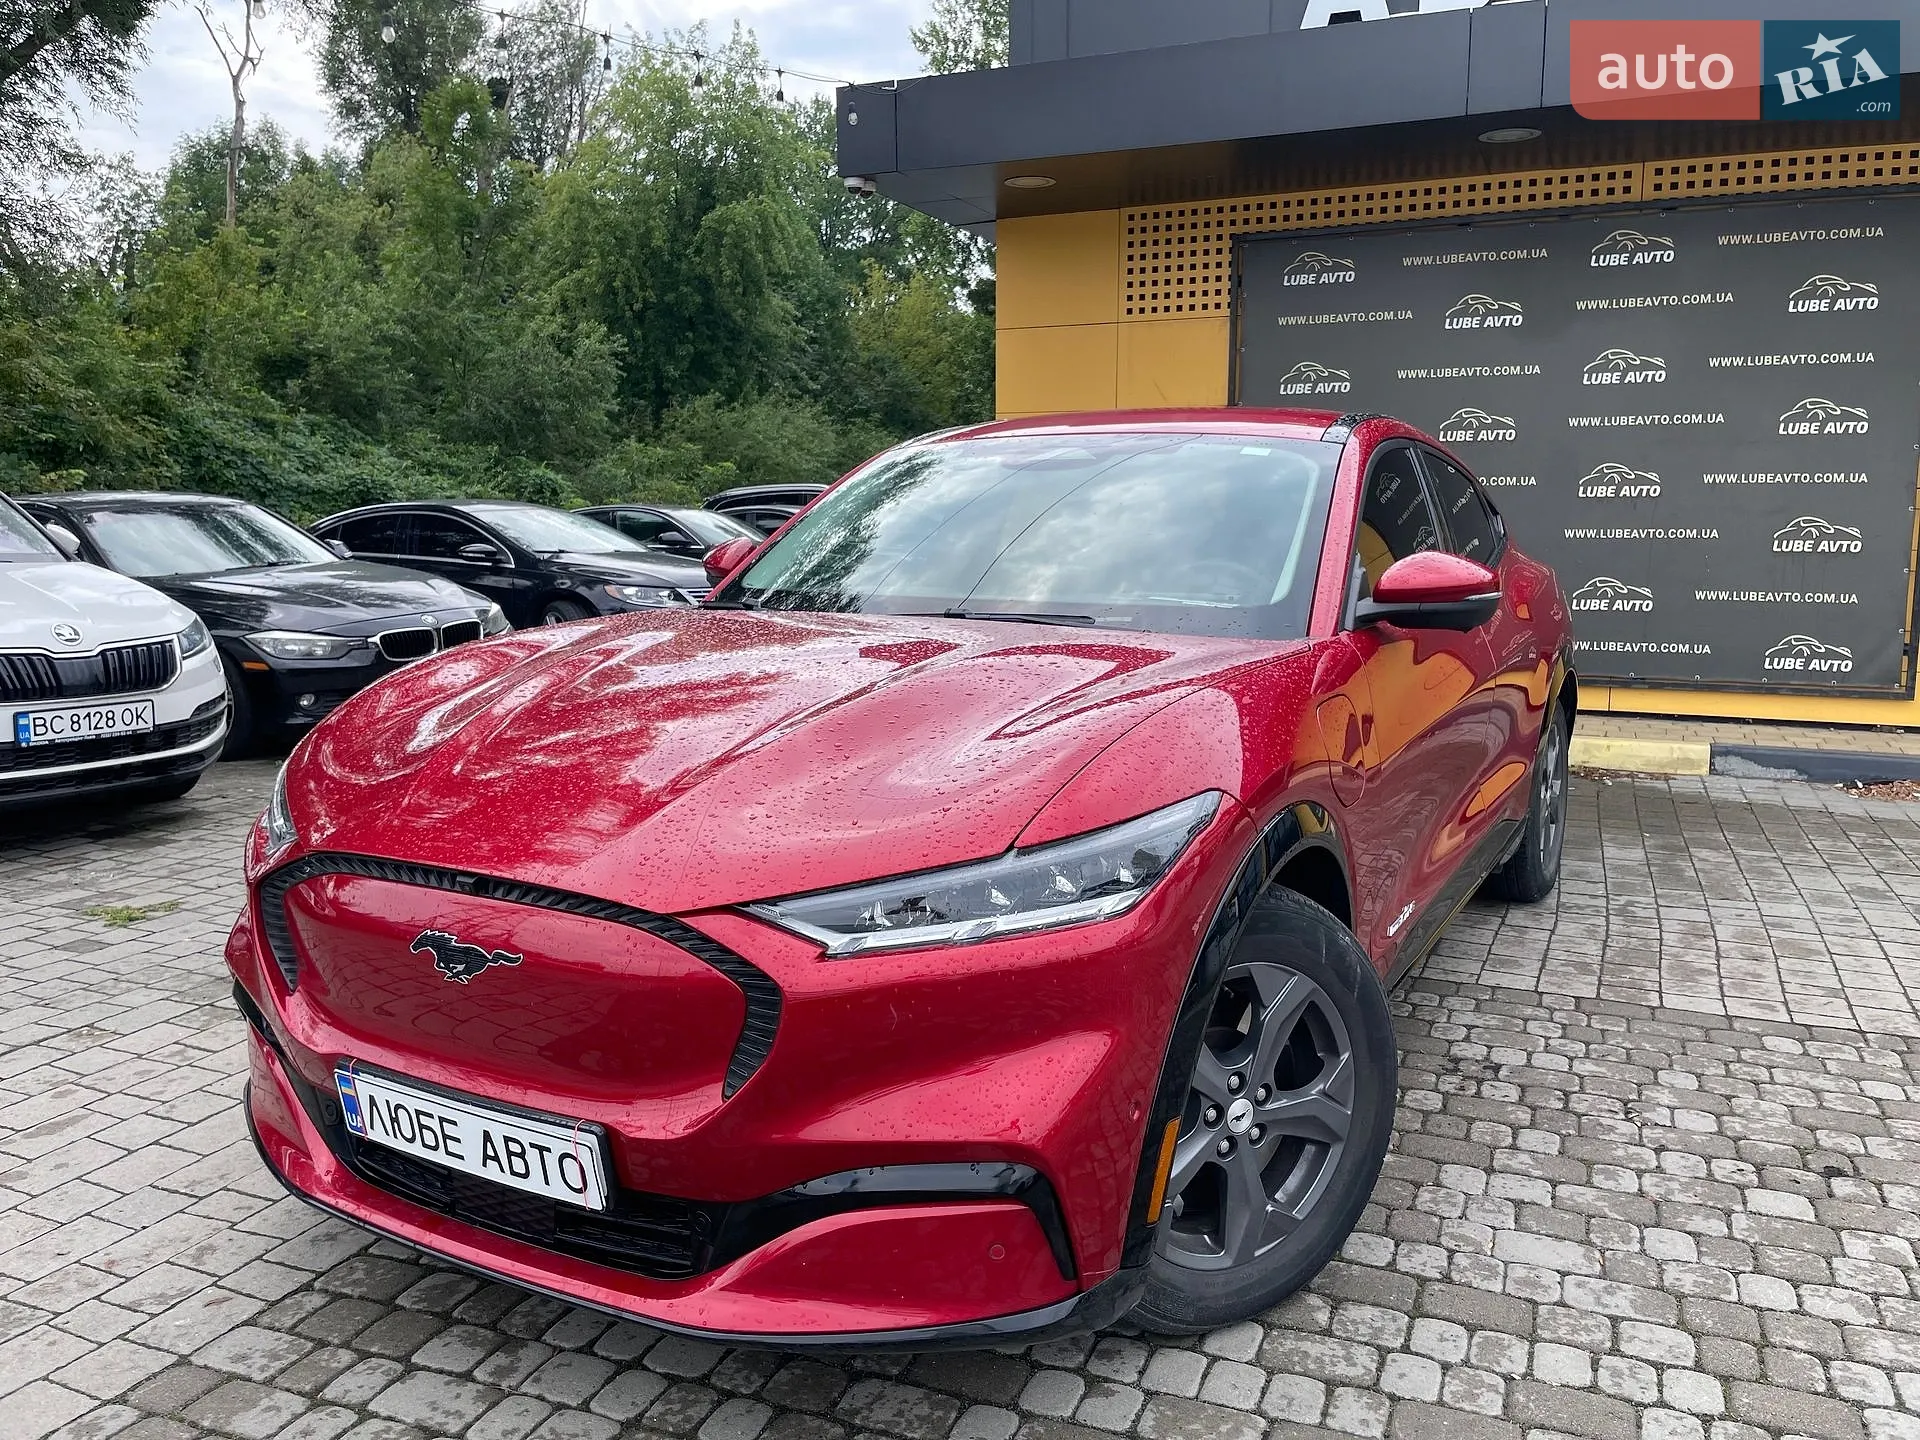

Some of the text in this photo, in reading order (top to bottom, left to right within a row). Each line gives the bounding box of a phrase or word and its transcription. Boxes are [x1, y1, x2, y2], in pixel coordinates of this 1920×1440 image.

[1718, 227, 1883, 245] WWW.LUBEAVTO.COM.UA
[1403, 249, 1548, 266] WWW.LUBEAVTO.COM.UA
[1591, 250, 1674, 266] LUBE AVTO
[1284, 271, 1355, 285] LUBE AVTO
[1576, 292, 1733, 310] WWW.LUBEAVTO.COM.UA
[1789, 297, 1878, 312] LUBE AVTO
[1278, 310, 1413, 325] WWW.LUBEAVTO.COM.UA
[1445, 315, 1522, 329] LUBE AVTO
[1709, 353, 1874, 367] WWW.LUBEAVTO.COM.UA
[1398, 365, 1540, 379] WWW.LUBEAVTO.COM.UA
[1583, 370, 1666, 384] LUBE AVTO
[1280, 382, 1350, 394] LUBE AVTO
[1569, 413, 1724, 427] WWW.LUBEAVTO.COM.UA
[1439, 429, 1515, 441] LUBE AVTO
[1779, 422, 1868, 434] LUBE AVTO
[1703, 473, 1868, 483] WWW.LUBEAVTO.COM.UA
[1579, 485, 1660, 497] LUBE AVTO
[1565, 529, 1718, 538] WWW.LUBEAVTO.COM.UA
[1773, 540, 1862, 552] LUBE AVTO
[1695, 590, 1858, 604] WWW.LUBEAVTO.COM.UA
[1572, 599, 1653, 611] LUBE AVTO
[1764, 658, 1852, 672] LUBE AVTO
[32, 706, 149, 737] BC 8128 OK
[19, 731, 30, 739] UA
[368, 1093, 589, 1195] ЛЮБЕ АВТО
